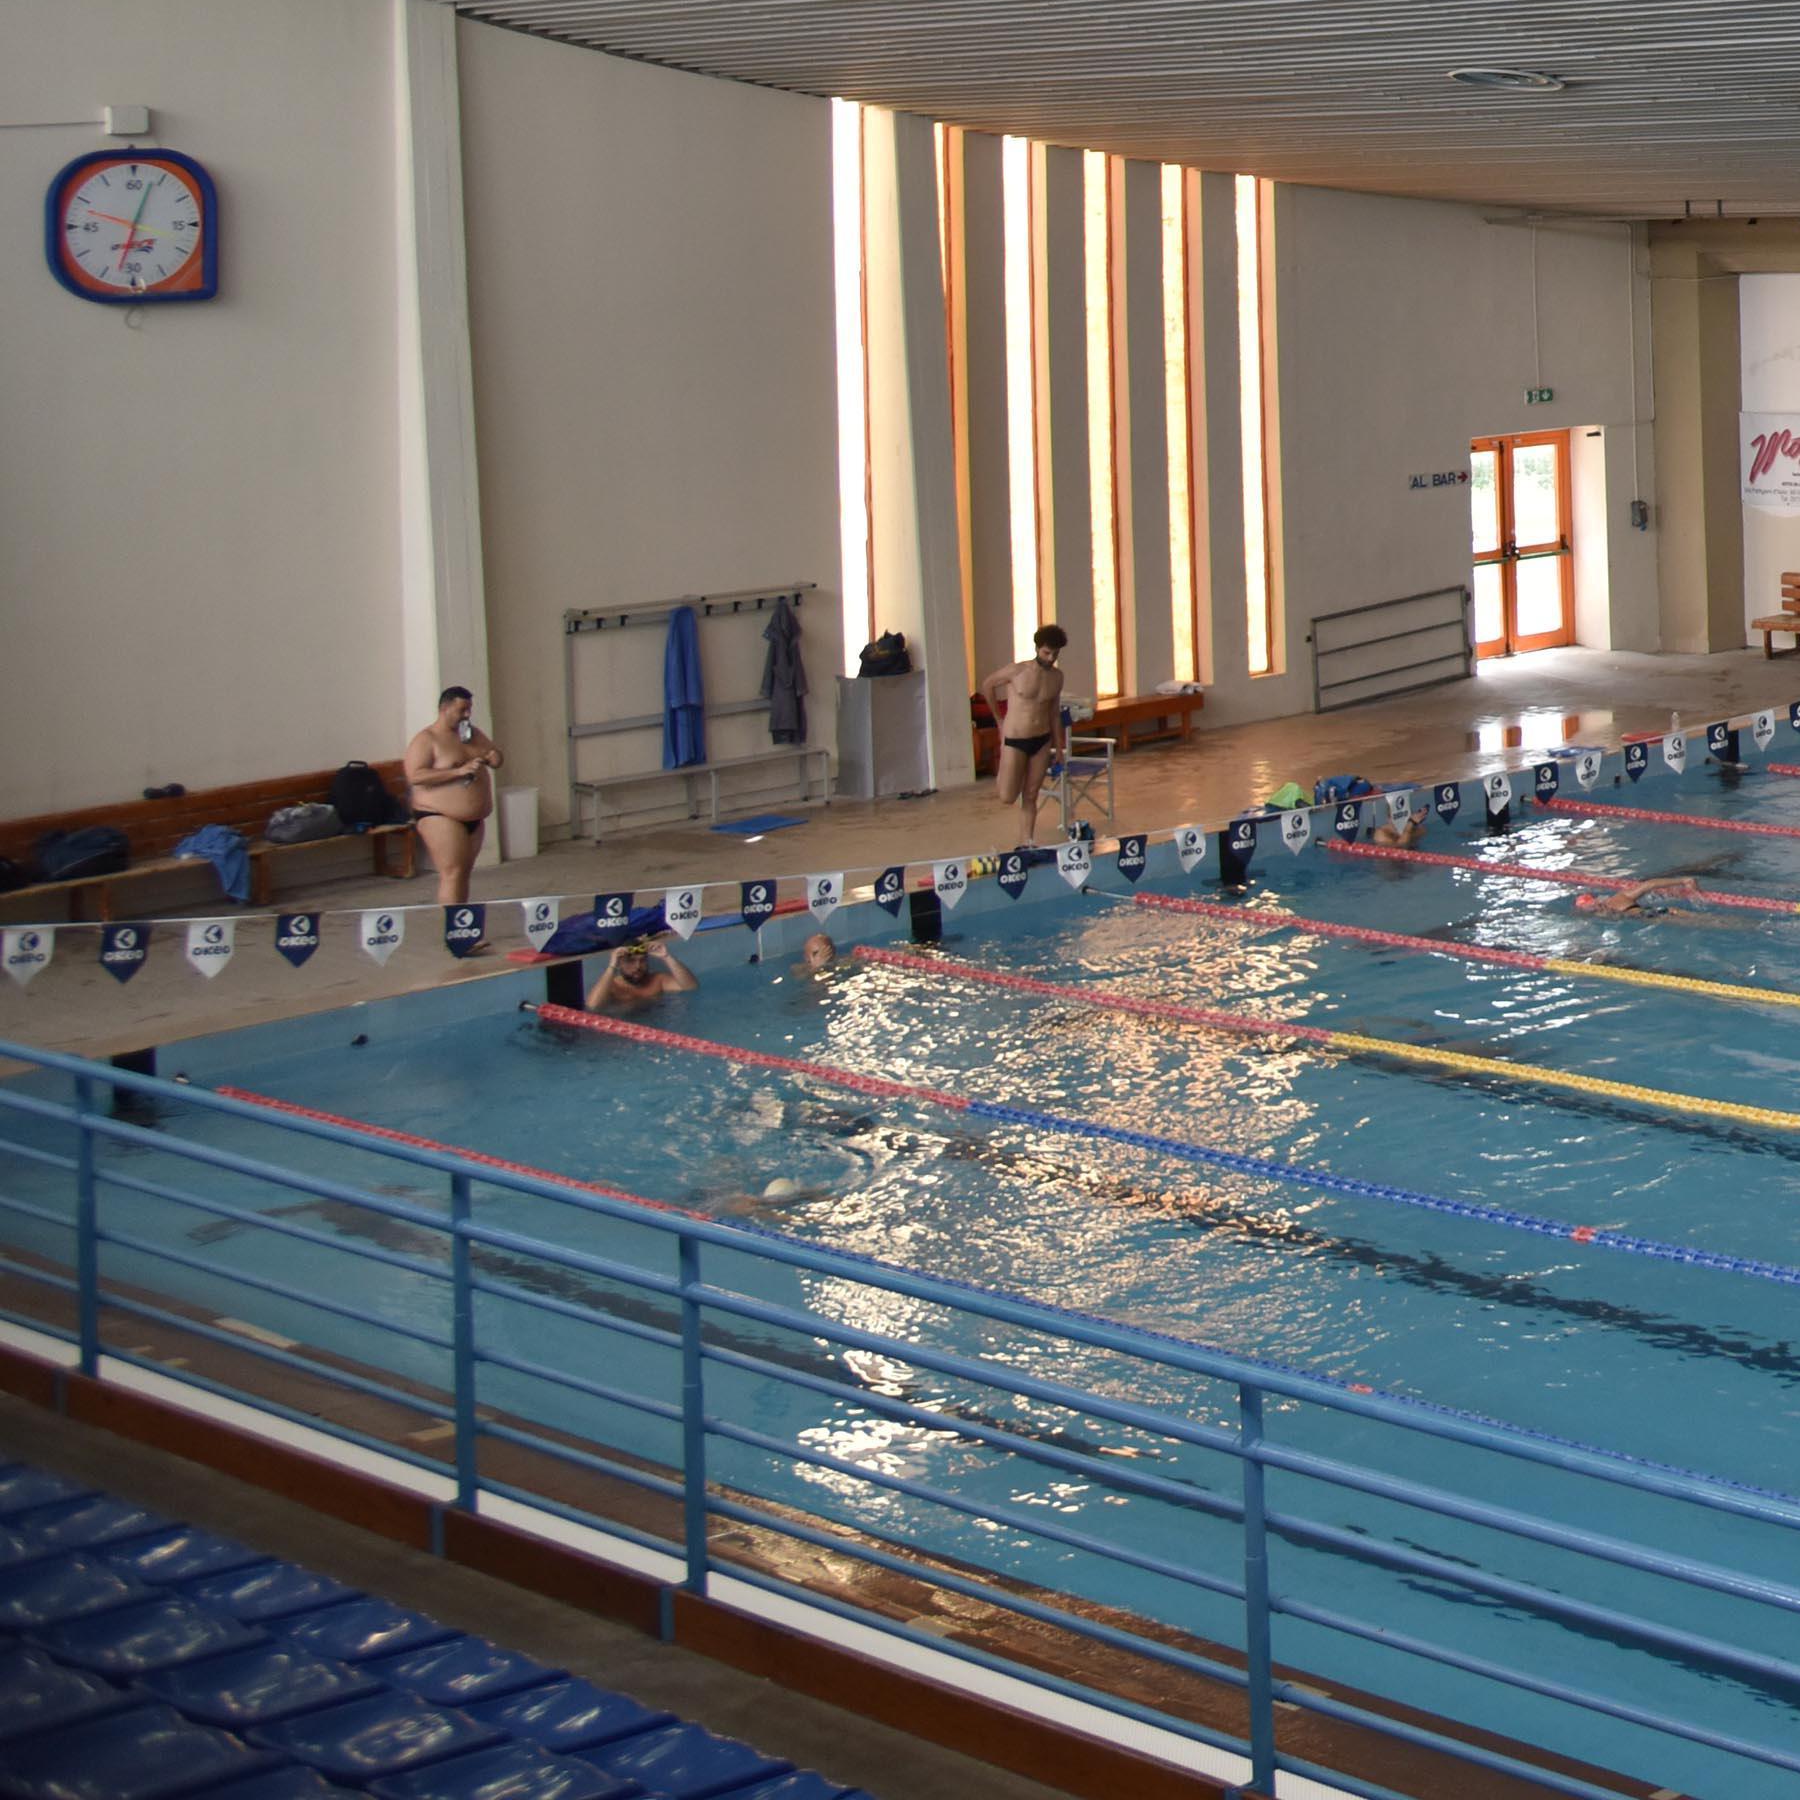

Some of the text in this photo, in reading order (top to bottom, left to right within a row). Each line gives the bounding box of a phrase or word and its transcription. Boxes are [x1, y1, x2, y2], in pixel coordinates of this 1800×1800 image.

[126, 179, 143, 190] 60
[82, 221, 99, 233] 45
[173, 219, 187, 231] 15
[126, 264, 143, 275] 30
[1410, 472, 1457, 489] AL BAR
